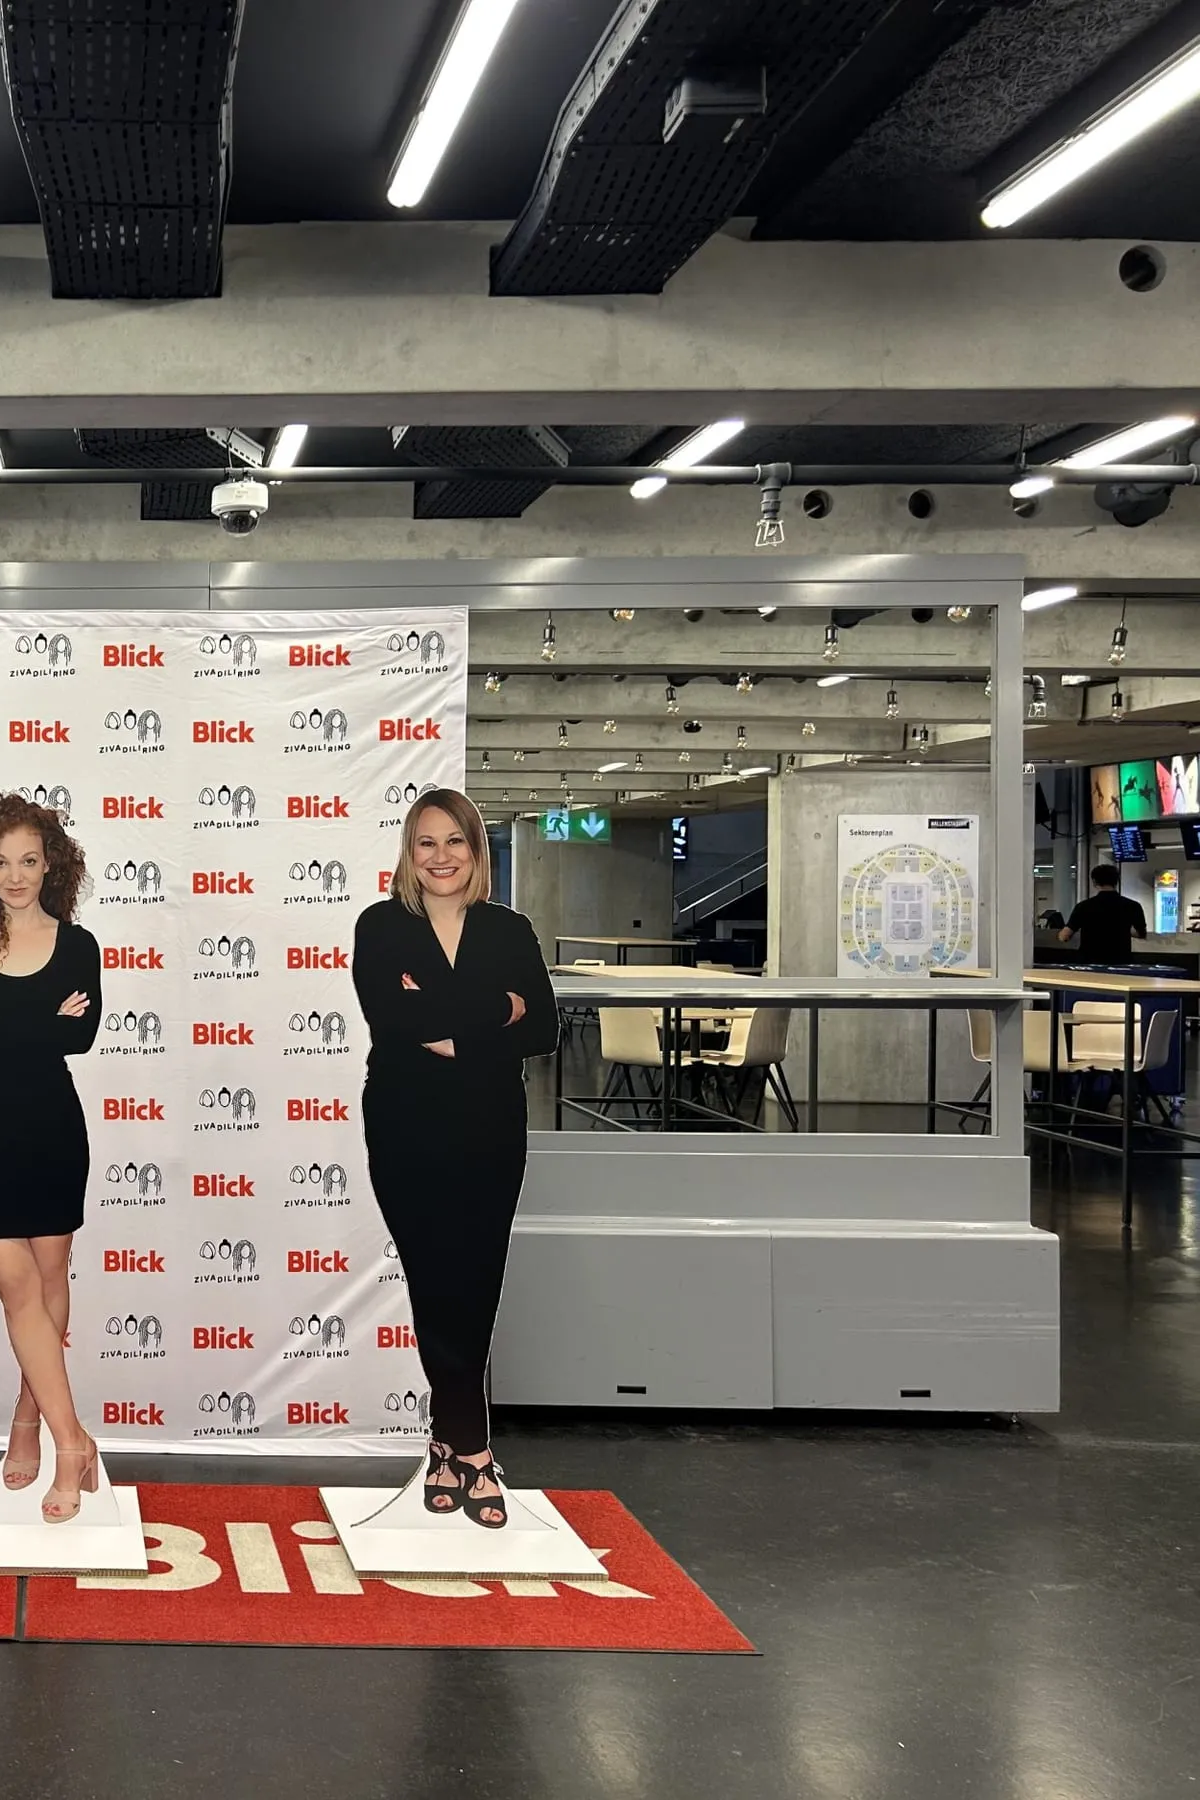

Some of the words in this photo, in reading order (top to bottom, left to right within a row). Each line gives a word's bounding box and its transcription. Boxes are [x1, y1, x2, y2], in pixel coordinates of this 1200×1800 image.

[104, 646, 163, 666] Blick
[290, 646, 349, 666] Blick
[10, 722, 68, 742] Blick
[194, 722, 253, 742] Blick
[380, 719, 440, 740] Blick
[104, 798, 163, 818] Blick
[288, 797, 347, 817] Blick
[849, 828, 894, 838] Sektorenplan
[193, 873, 252, 893] Blick
[104, 948, 162, 968] Blick
[288, 948, 347, 969] Blick
[194, 1024, 252, 1044] Blick
[104, 1099, 163, 1120] Blick
[288, 1100, 347, 1120] Blick
[194, 1175, 252, 1196] Blick
[105, 1250, 163, 1272] Blick
[288, 1250, 347, 1272] Blick
[194, 1328, 252, 1349] Blick
[378, 1326, 417, 1348] Bli
[104, 1403, 163, 1424] Blick
[288, 1403, 348, 1424] Blick
[76, 1522, 655, 1600] Bli
